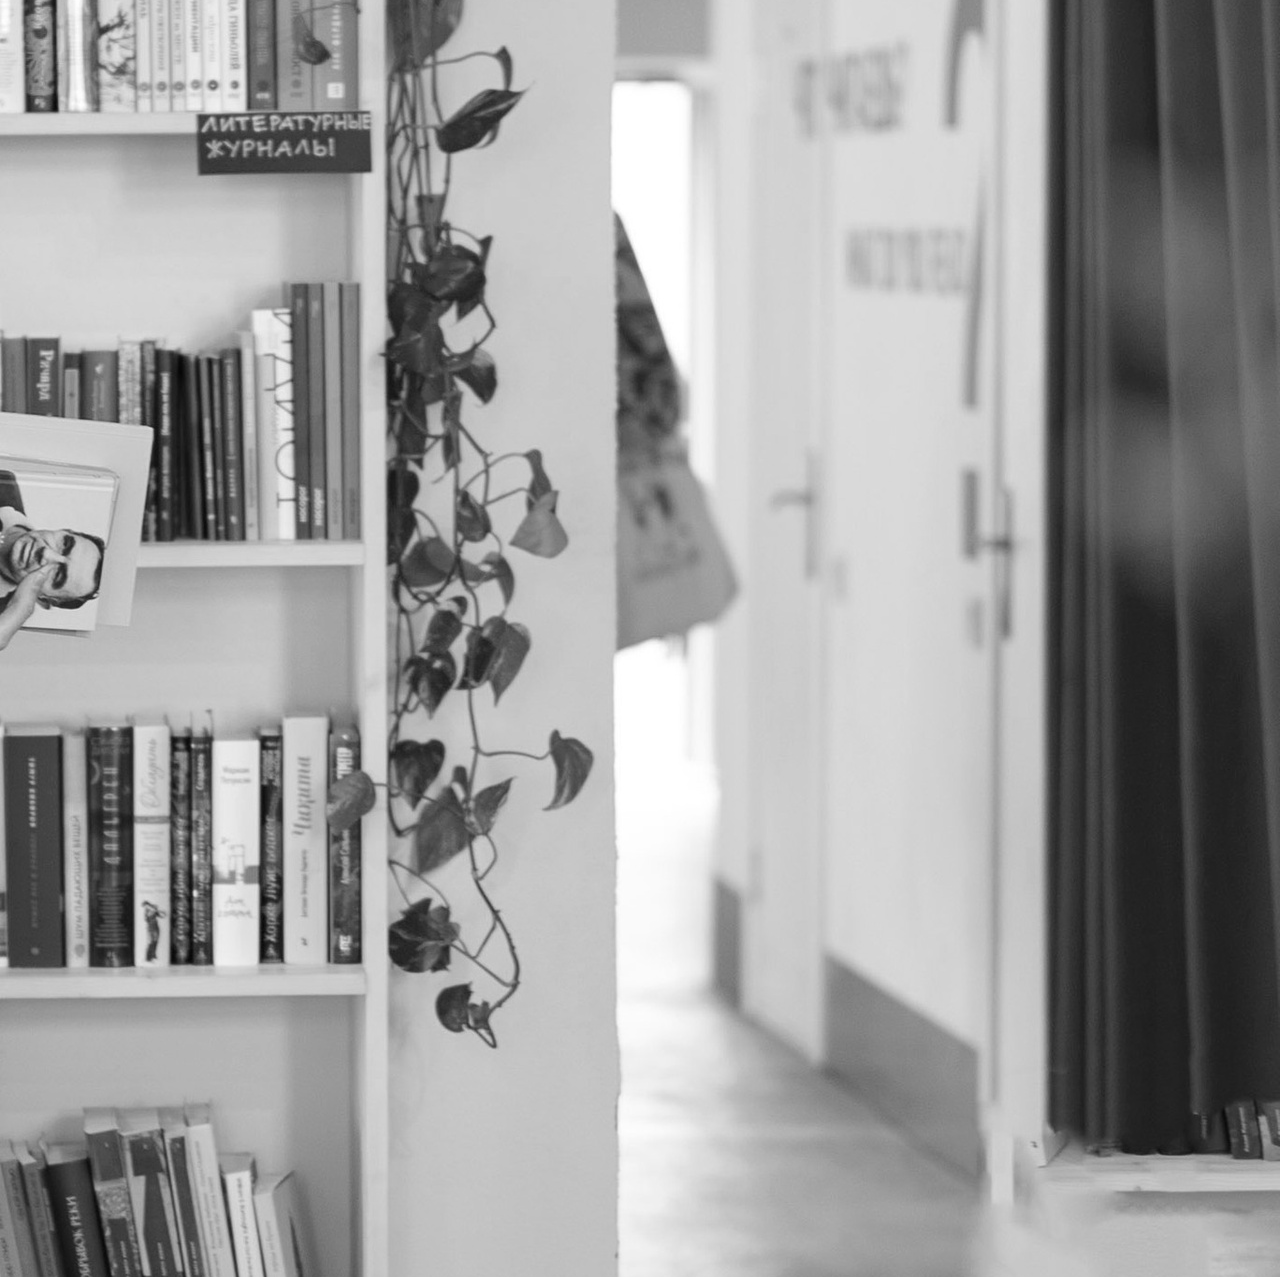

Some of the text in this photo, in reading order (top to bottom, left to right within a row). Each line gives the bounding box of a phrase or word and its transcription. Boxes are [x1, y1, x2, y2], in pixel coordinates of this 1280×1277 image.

[201, 114, 371, 133] ЛИТЕРАТУРНЫЕ
[205, 137, 336, 159] ЖУРНАЛЫ
[36, 350, 55, 400] Ричард
[66, 1196, 84, 1226] РЕКИ
